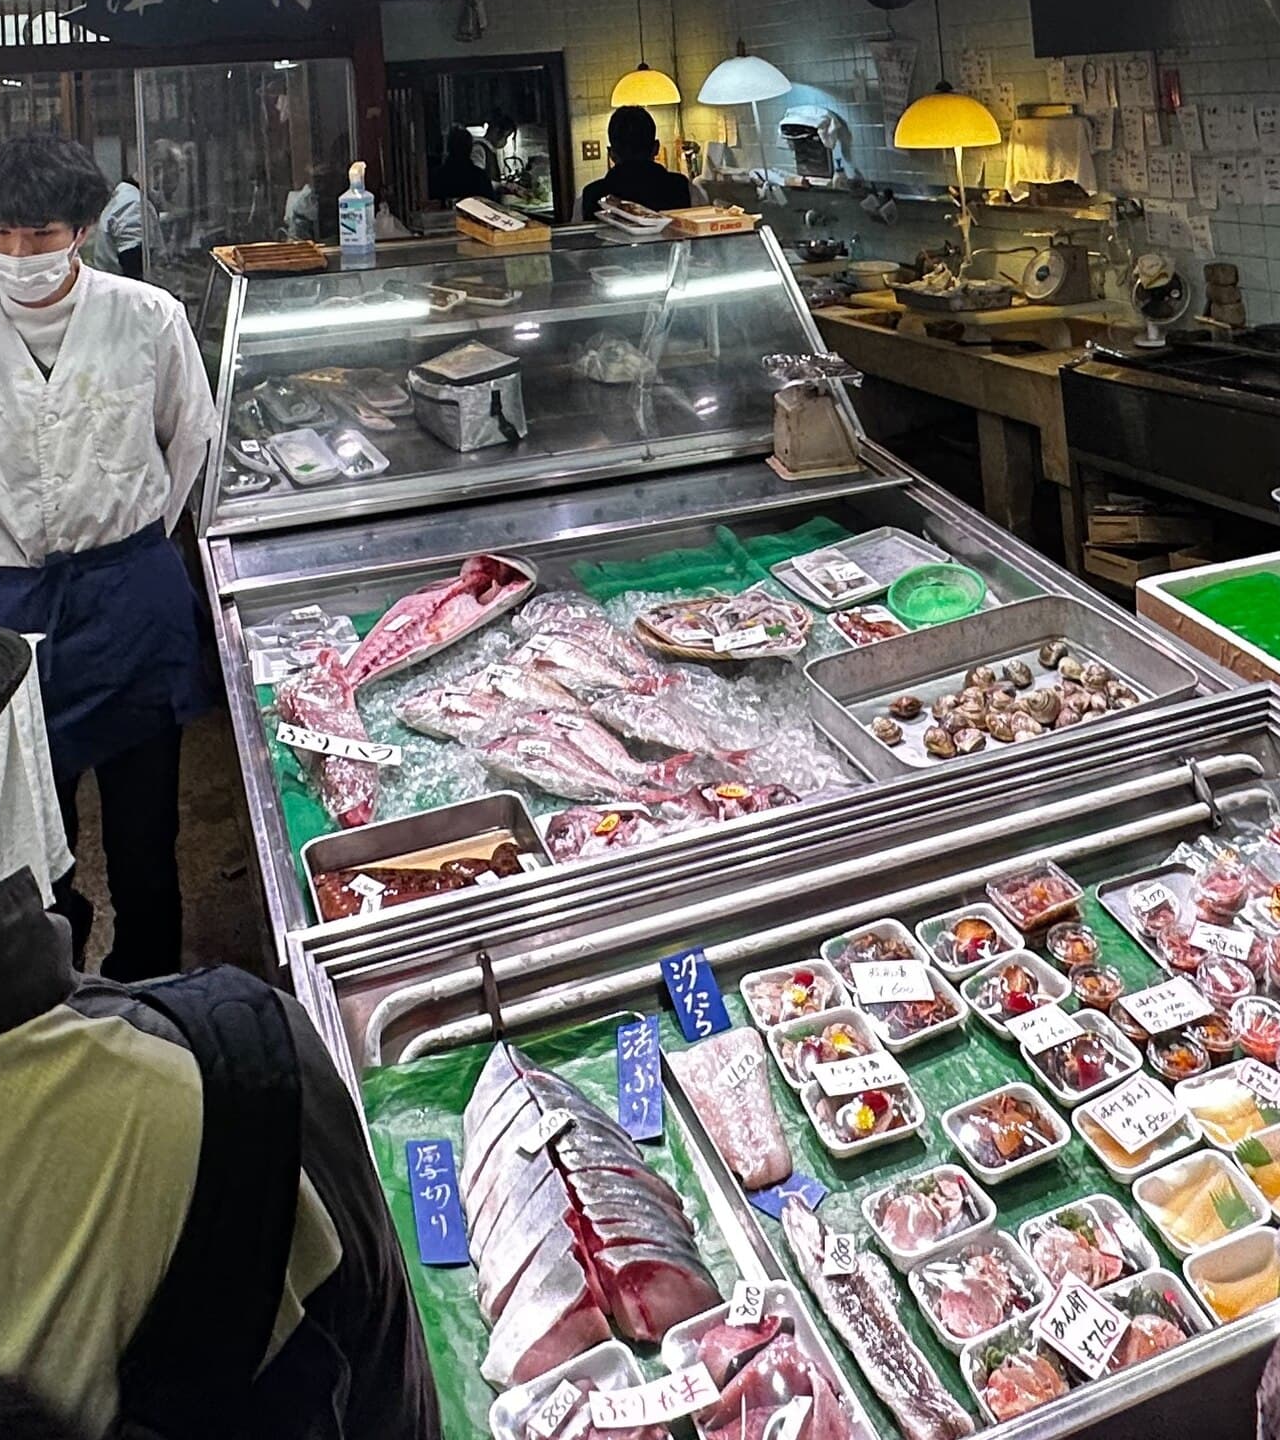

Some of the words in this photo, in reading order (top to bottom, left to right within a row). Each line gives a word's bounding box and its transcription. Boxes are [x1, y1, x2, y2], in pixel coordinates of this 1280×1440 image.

[669, 953, 713, 1037] 汐たら
[622, 1022, 658, 1129] 活ぶり
[415, 1144, 451, 1240] 厚切り
[540, 1387, 576, 1429] 850
